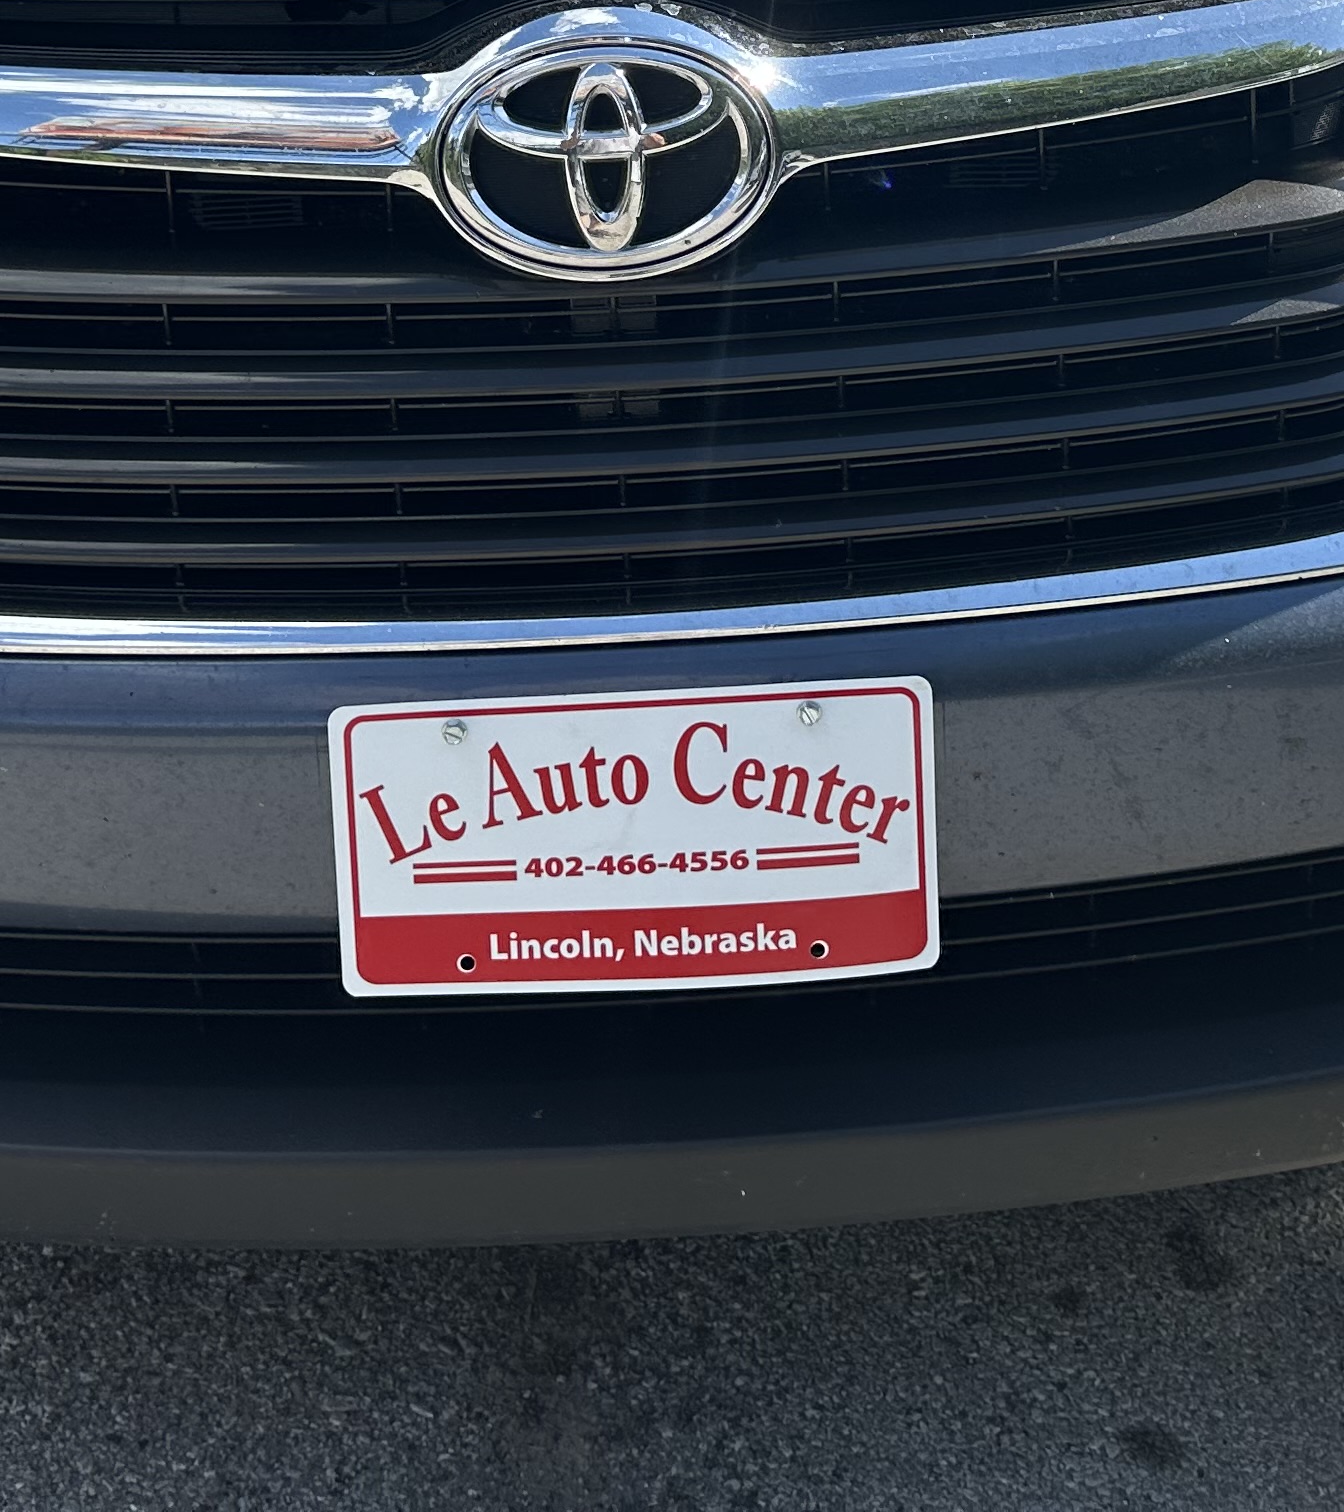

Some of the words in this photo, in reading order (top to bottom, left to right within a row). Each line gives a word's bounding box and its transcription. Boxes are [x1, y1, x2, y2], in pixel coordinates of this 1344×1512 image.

[359, 784, 468, 865] Le
[481, 741, 650, 829] Auto
[672, 721, 911, 845] Center
[523, 848, 750, 879] 402-466-4556
[488, 929, 625, 963] Lincoln,
[634, 923, 797, 958] Nebraska
